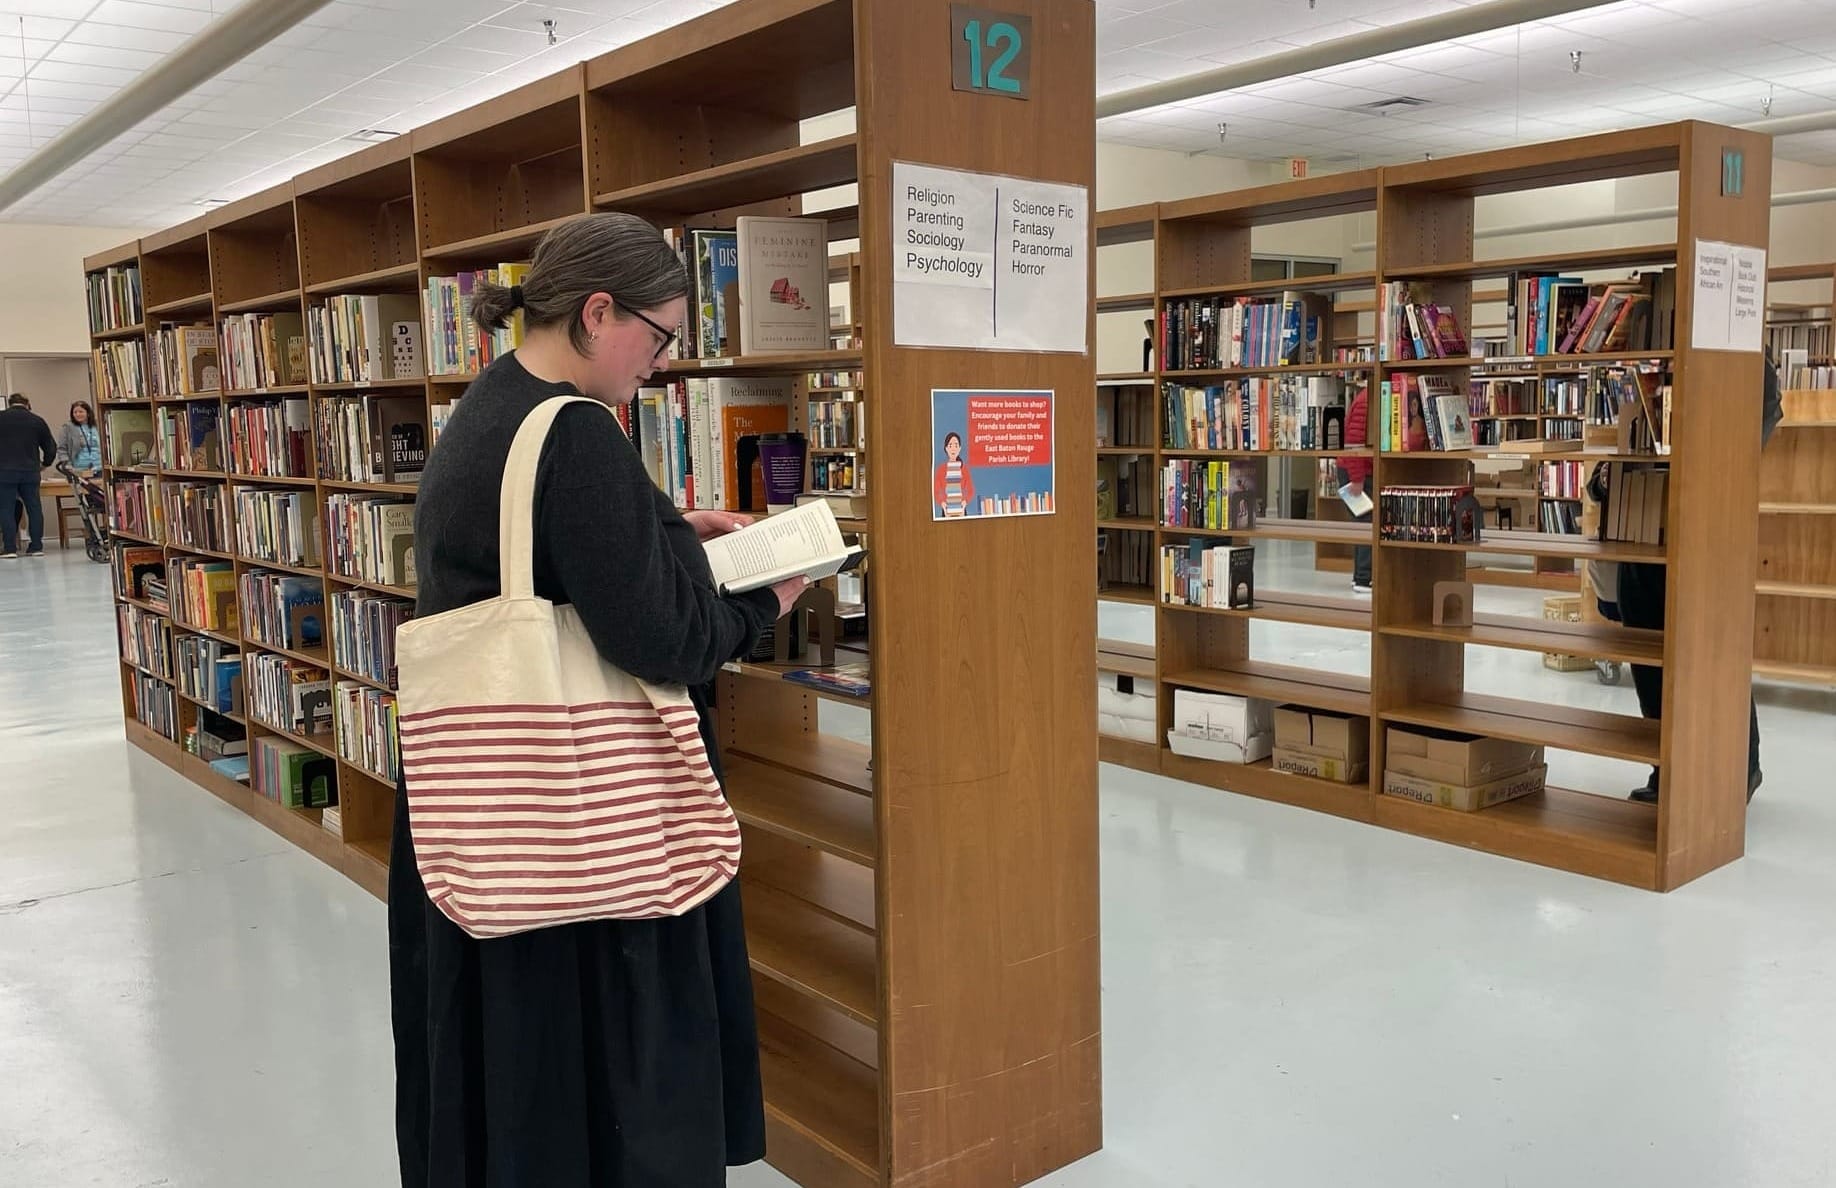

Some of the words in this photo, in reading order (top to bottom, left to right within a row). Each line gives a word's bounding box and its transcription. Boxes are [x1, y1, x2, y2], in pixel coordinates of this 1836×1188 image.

[963, 19, 1022, 93] 12
[1292, 160, 1306, 178] EXIT
[1726, 152, 1742, 194] 11
[907, 186, 955, 206] Religion
[1012, 199, 1055, 217] Science
[1058, 204, 1074, 219] Fic
[907, 208, 964, 230] Parenting
[1012, 220, 1055, 239] Fantasy
[907, 230, 965, 251] Sociology
[1012, 241, 1073, 258] Paranormal
[907, 252, 983, 278] Psychology
[1012, 260, 1045, 276] Horror
[1030, 401, 1047, 409] shop?
[733, 416, 753, 428] The
[971, 411, 1002, 420] Encourage
[1017, 411, 1035, 420] family
[977, 422, 998, 430] friends
[1027, 422, 1041, 430] their
[974, 434, 993, 443] gently
[1017, 445, 1034, 453] Rouge
[988, 455, 1007, 463] Parish
[1007, 455, 1030, 464] Library!
